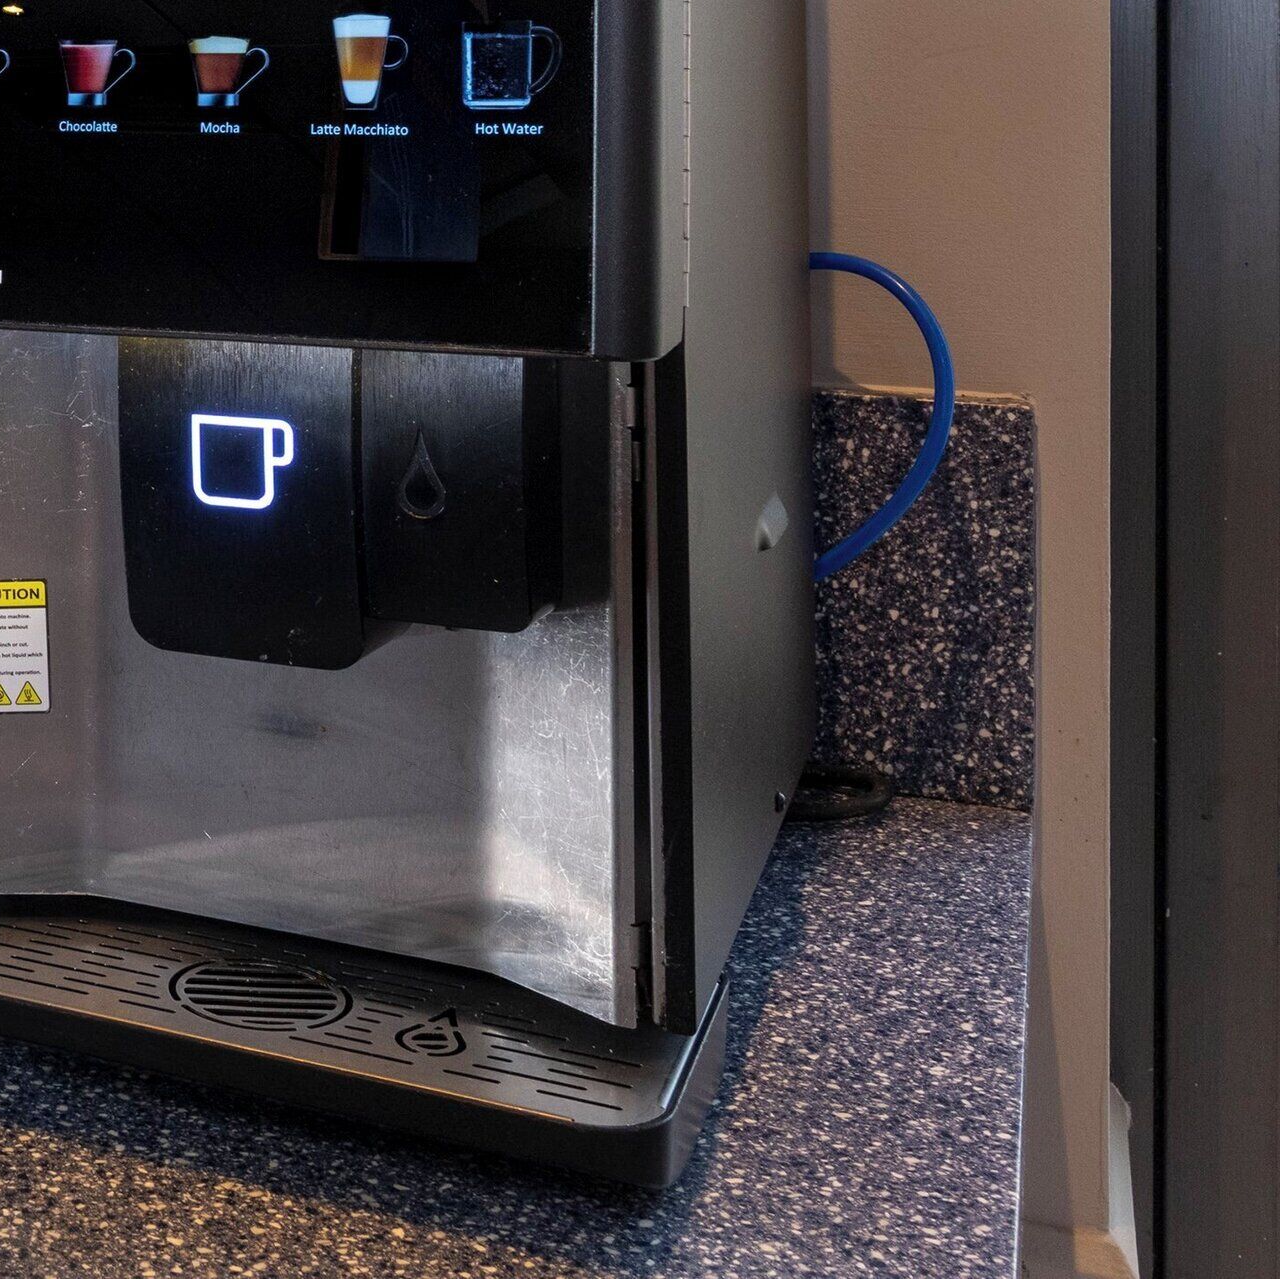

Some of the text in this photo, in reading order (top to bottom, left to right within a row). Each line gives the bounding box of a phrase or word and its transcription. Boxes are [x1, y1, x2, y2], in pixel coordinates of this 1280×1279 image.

[58, 120, 118, 133] Chocolatte
[200, 121, 240, 134] Mocha
[310, 123, 409, 136] Latte Macchiato
[475, 122, 543, 135] Hot Water
